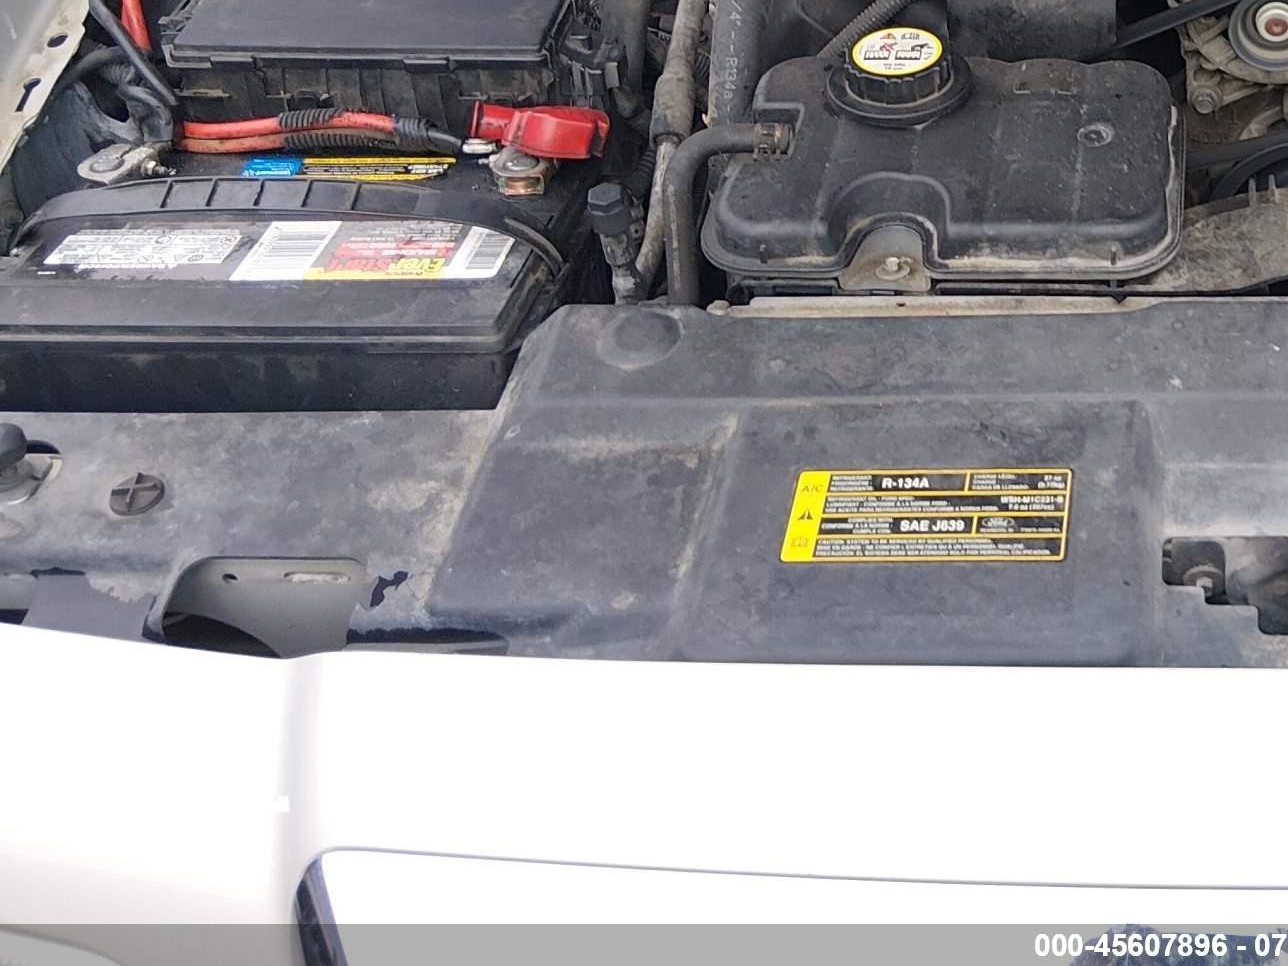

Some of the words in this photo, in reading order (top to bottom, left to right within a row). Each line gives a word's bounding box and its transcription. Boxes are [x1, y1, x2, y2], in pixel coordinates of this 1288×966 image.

[881, 477, 929, 489] R-134A
[900, 520, 929, 532] SAE
[932, 520, 965, 532] J639
